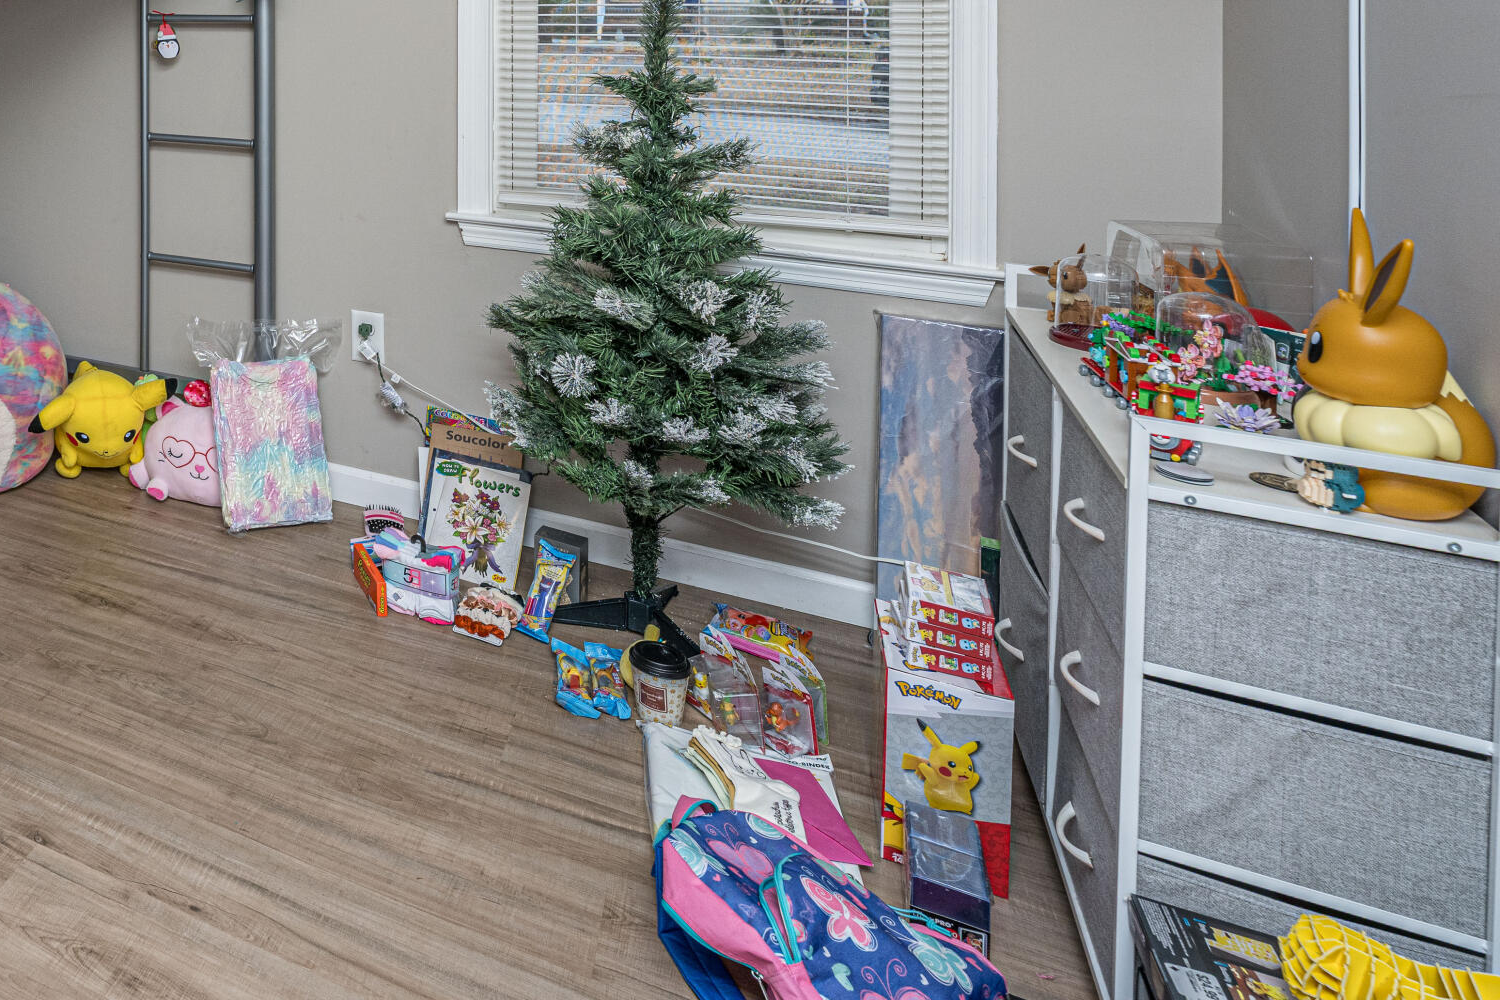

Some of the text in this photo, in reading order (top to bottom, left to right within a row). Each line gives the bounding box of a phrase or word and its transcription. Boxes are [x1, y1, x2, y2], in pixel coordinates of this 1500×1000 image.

[446, 430, 507, 450] Soucolor
[458, 465, 521, 497] Flowers
[894, 680, 963, 711] Pokémon
